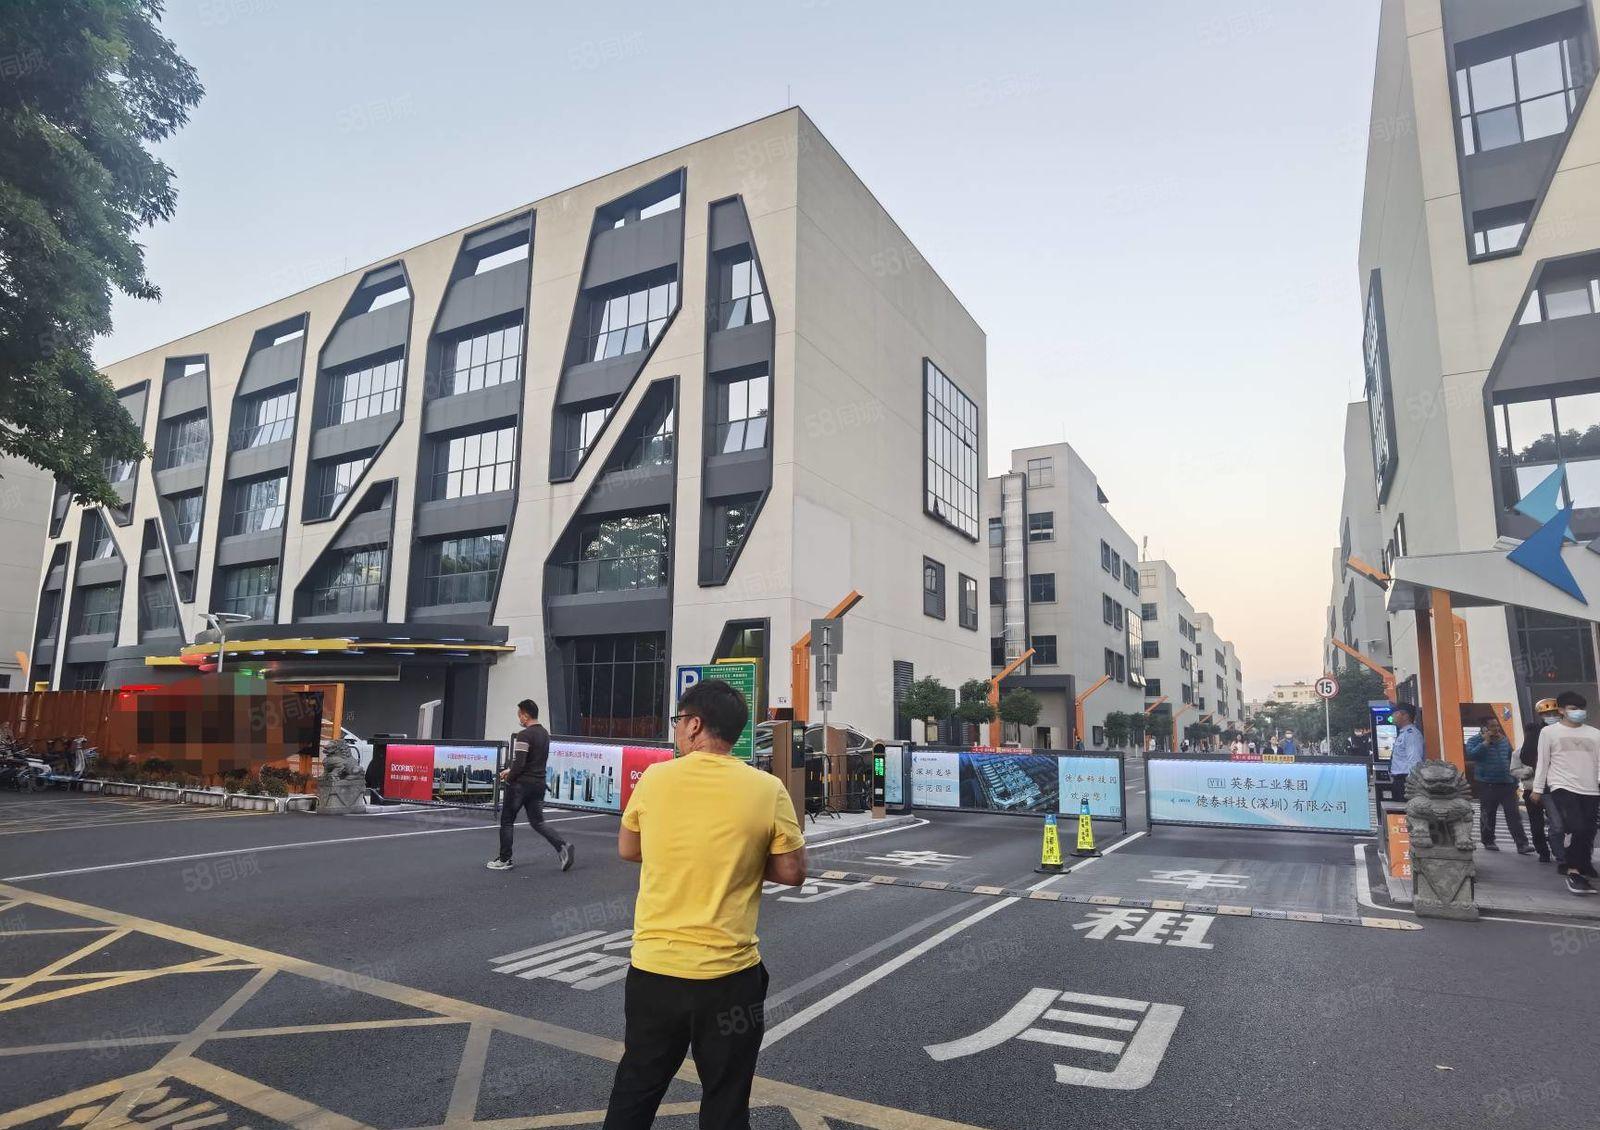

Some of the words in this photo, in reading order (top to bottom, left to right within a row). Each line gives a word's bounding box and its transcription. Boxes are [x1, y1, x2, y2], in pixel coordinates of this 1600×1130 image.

[681, 671, 699, 696] P
[1320, 681, 1332, 693] 15
[1376, 716, 1384, 725] P
[1065, 774, 1117, 784] 德泰科技园
[1231, 777, 1308, 791] 英泰工业集团
[1195, 795, 1347, 813] 德泰科技(深圳)有限公司
[1072, 907, 1215, 950] 租
[923, 987, 1185, 1090] 月
